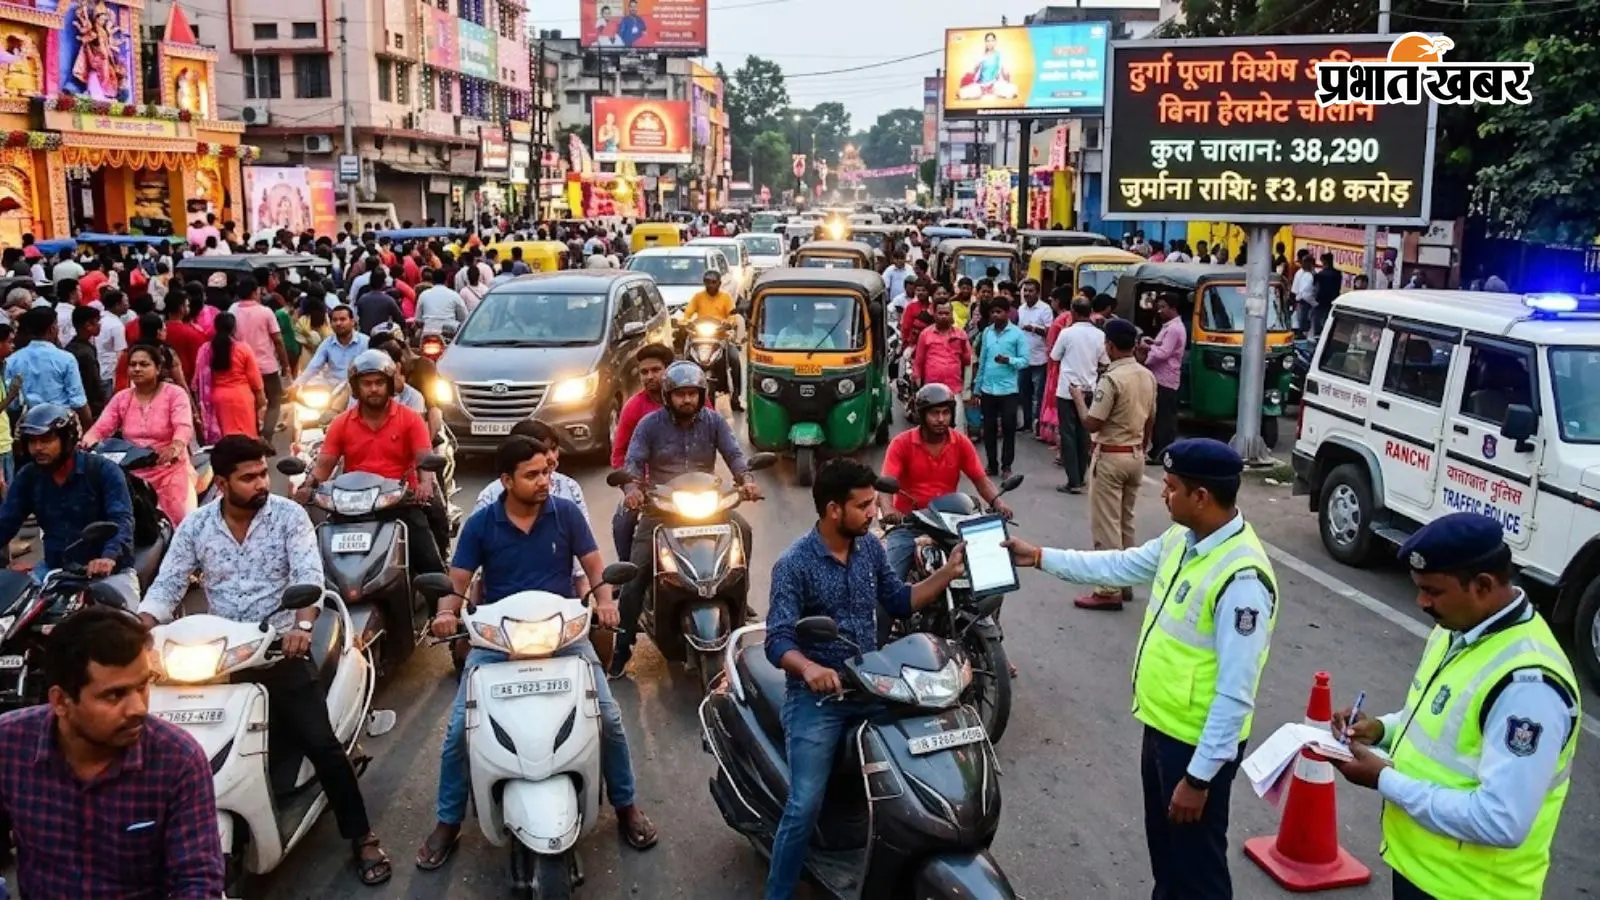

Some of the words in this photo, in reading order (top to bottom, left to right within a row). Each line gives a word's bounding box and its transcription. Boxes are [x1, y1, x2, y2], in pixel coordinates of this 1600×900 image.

[1128, 52, 1173, 92] दुर्गा
[1176, 61, 1225, 91] पूजा
[1231, 51, 1299, 82] विशेष
[1158, 93, 1211, 123] बिना
[1217, 91, 1292, 126] हेलमेट
[1150, 139, 1194, 168] कुल
[1200, 139, 1282, 162] चालान:
[1290, 138, 1379, 166] 38,290
[1119, 170, 1192, 207] जुर्माना
[1199, 171, 1257, 202] राशि:
[1265, 178, 1336, 203] ₹3.18
[1343, 172, 1413, 208] करोड़
[1385, 440, 1431, 471] RANCHI
[1443, 487, 1482, 515] TRAFFIC
[1490, 479, 1523, 505] पुलिस
